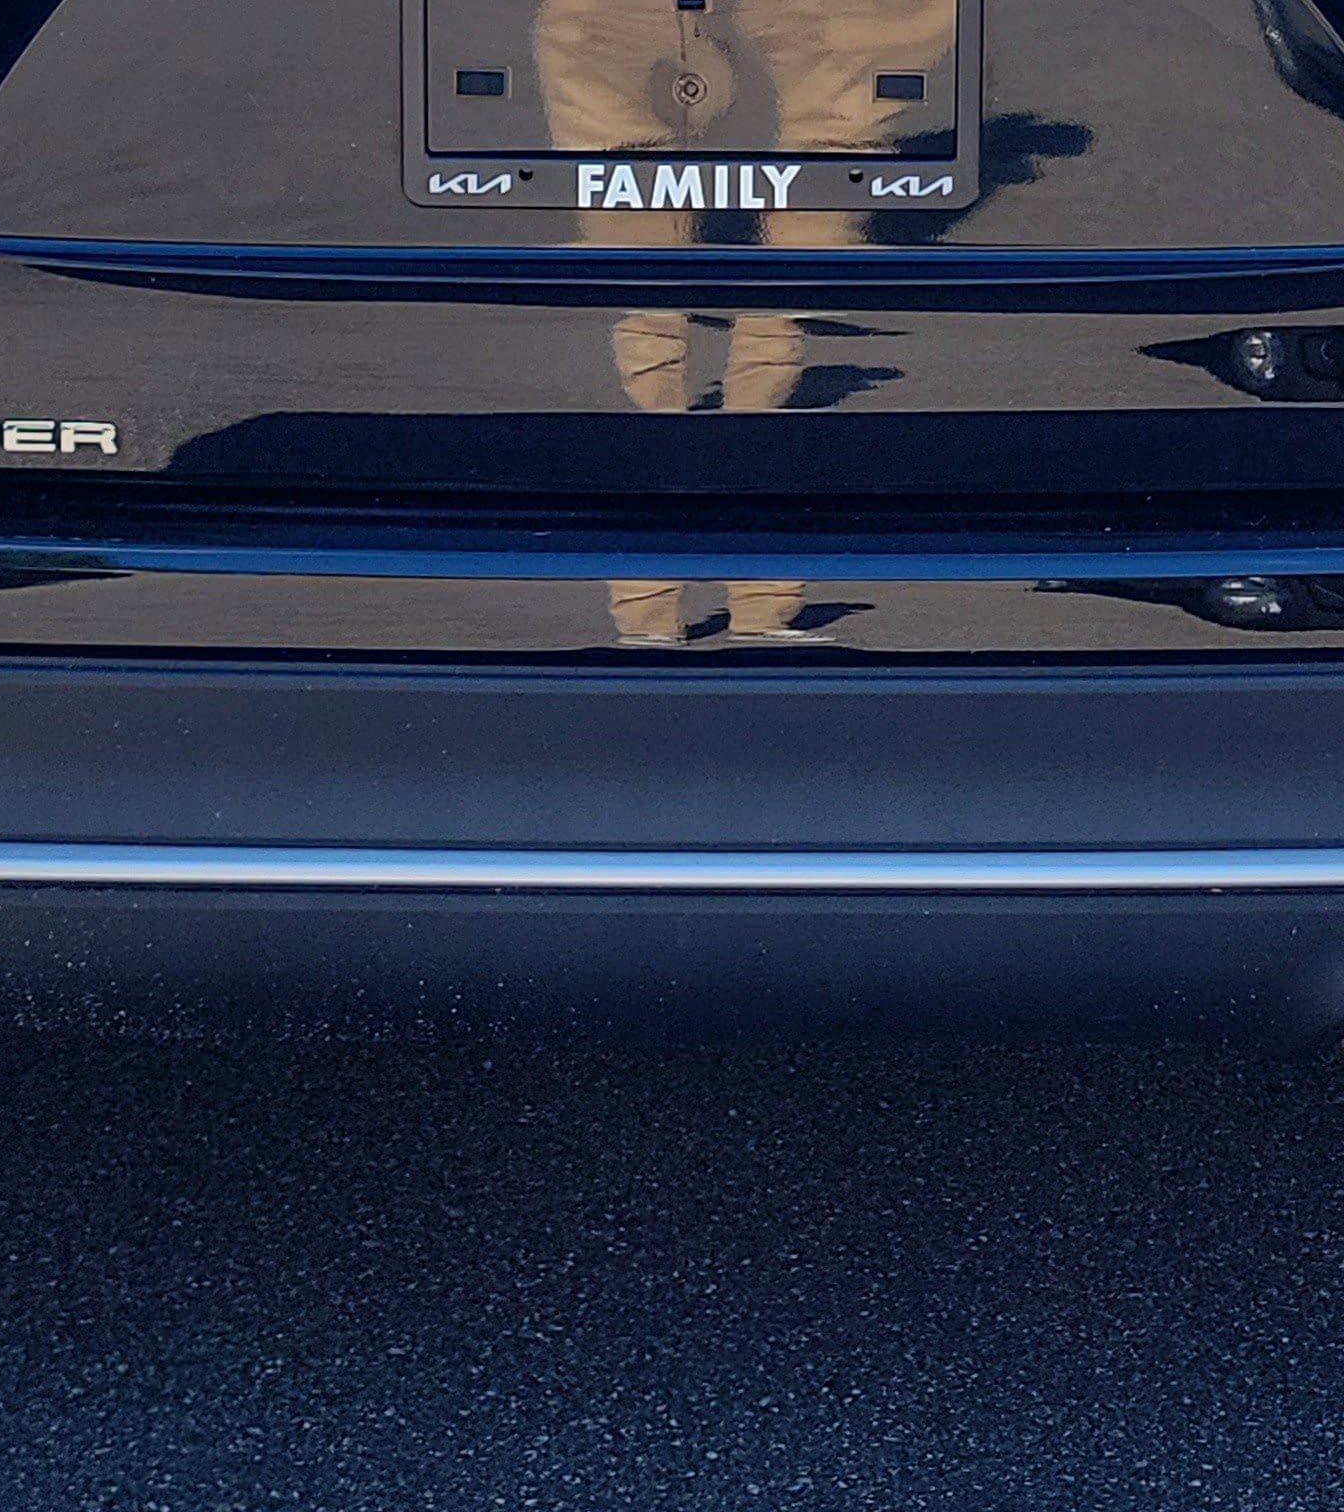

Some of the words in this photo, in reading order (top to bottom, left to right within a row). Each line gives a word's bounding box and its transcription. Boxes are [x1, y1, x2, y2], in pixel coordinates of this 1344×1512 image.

[428, 172, 513, 197] KIA
[576, 163, 802, 210] FAMILY
[871, 173, 953, 198] KIA
